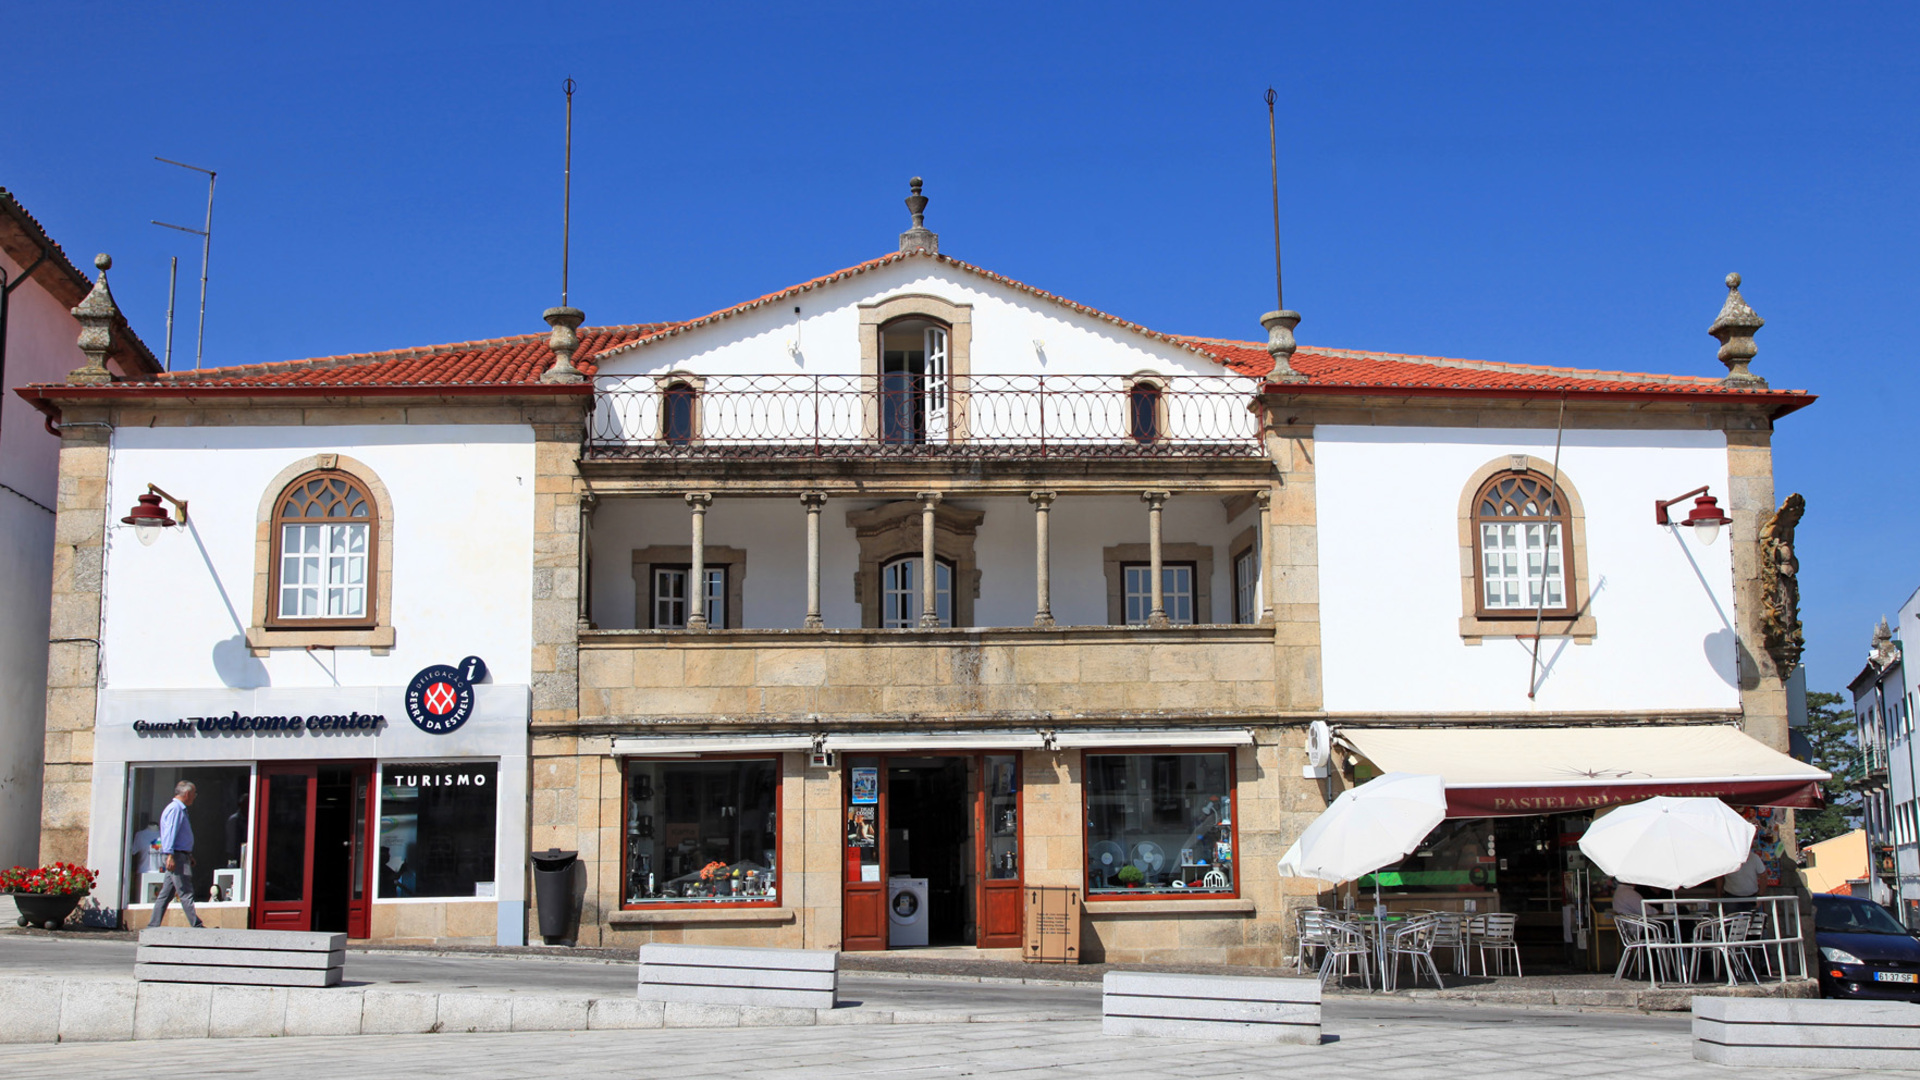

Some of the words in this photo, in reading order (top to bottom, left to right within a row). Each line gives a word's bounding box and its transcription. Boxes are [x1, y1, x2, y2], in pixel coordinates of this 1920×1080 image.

[409, 691, 425, 724] SERRA
[426, 720, 442, 730] DA
[444, 690, 469, 728] ESTRELA
[132, 719, 193, 733] Guarda
[187, 710, 302, 733] welcome
[305, 711, 385, 731] center
[394, 774, 486, 787] TURISMO
[1494, 794, 1625, 810] PASTELARIA
